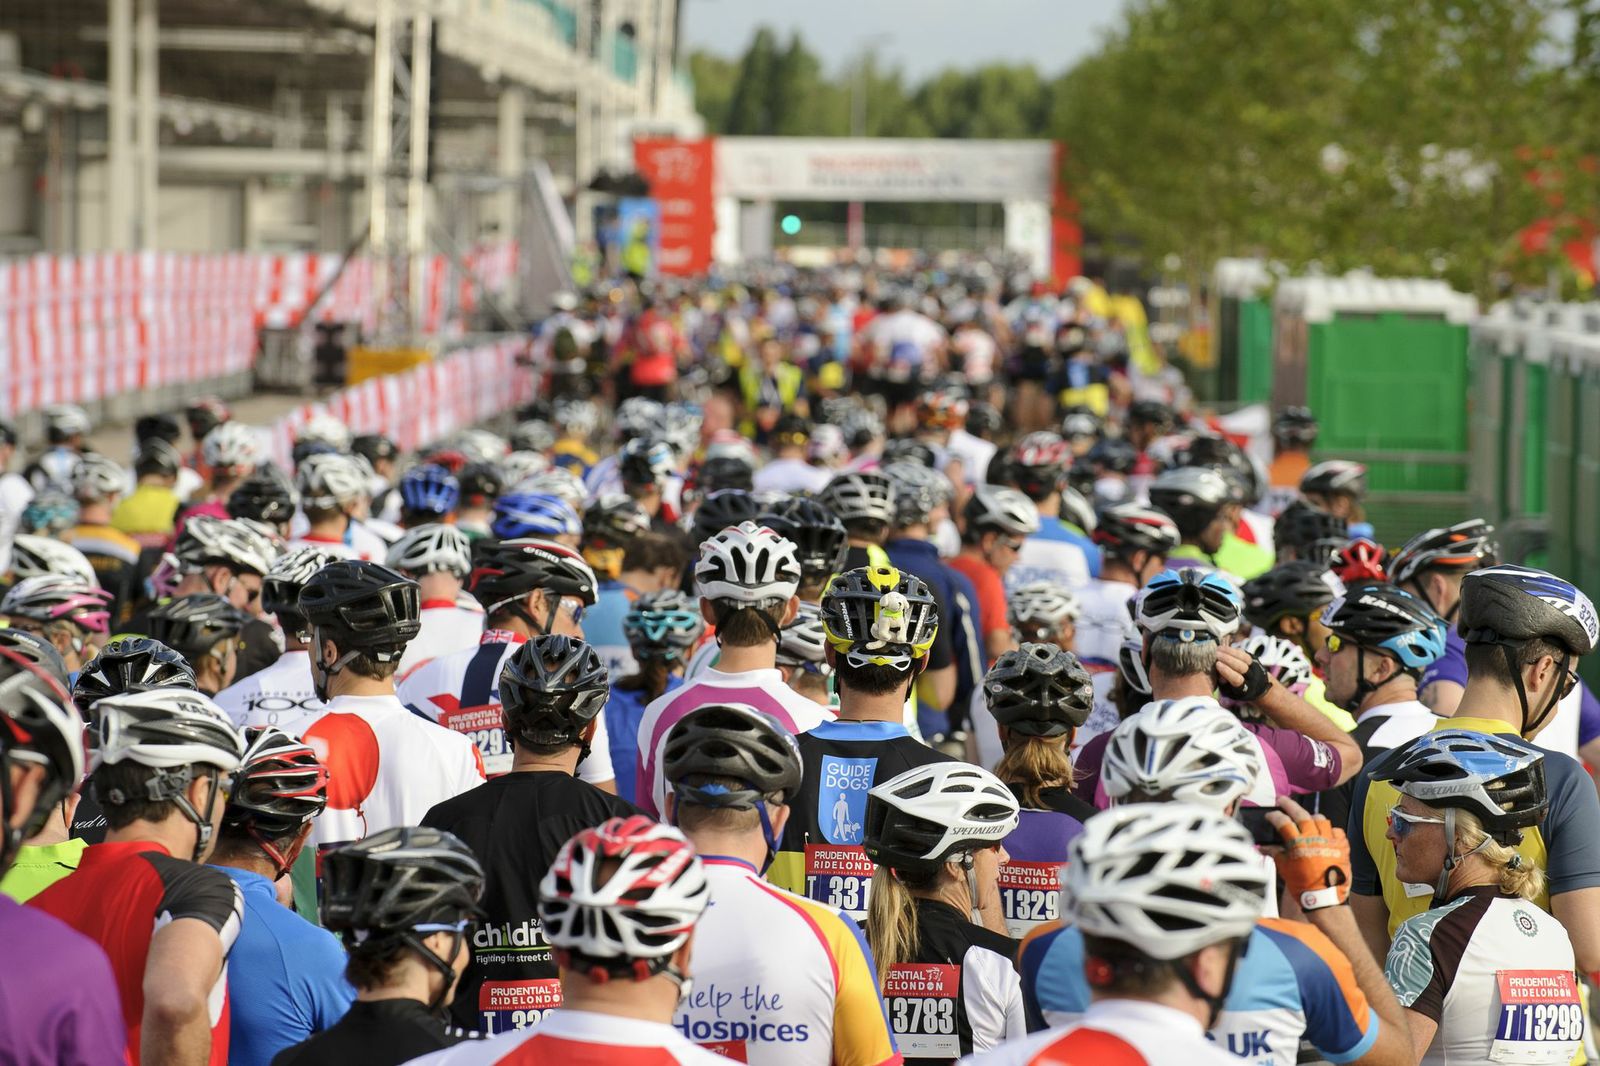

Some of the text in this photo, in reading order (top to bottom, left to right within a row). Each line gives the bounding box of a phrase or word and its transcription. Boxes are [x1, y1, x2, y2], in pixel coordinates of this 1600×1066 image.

[839, 601, 854, 639] PREVAIL
[448, 710, 499, 723] PRUDENTIAL
[827, 763, 872, 777] GUIDE
[825, 776, 870, 790] DOGS
[1420, 783, 1480, 795] SPECIALIZED
[951, 825, 1005, 835] SPECIALIZED
[814, 851, 870, 861] PRUDENTIAL
[998, 866, 1048, 877] RUDENTIAL
[807, 876, 872, 910] T 331
[1003, 889, 1060, 920] 1329
[476, 952, 553, 965] Fighting for street ch
[887, 981, 943, 991] ELONDON
[1509, 977, 1559, 987] PRUDENTIAL
[491, 986, 551, 996] PRUDENTIAL
[1510, 988, 1571, 998] RIDELONDON
[491, 994, 564, 1005] RIDELONDO
[740, 984, 784, 1012] the
[1504, 1004, 1582, 1041] T 13298
[1227, 1030, 1273, 1058] UK
